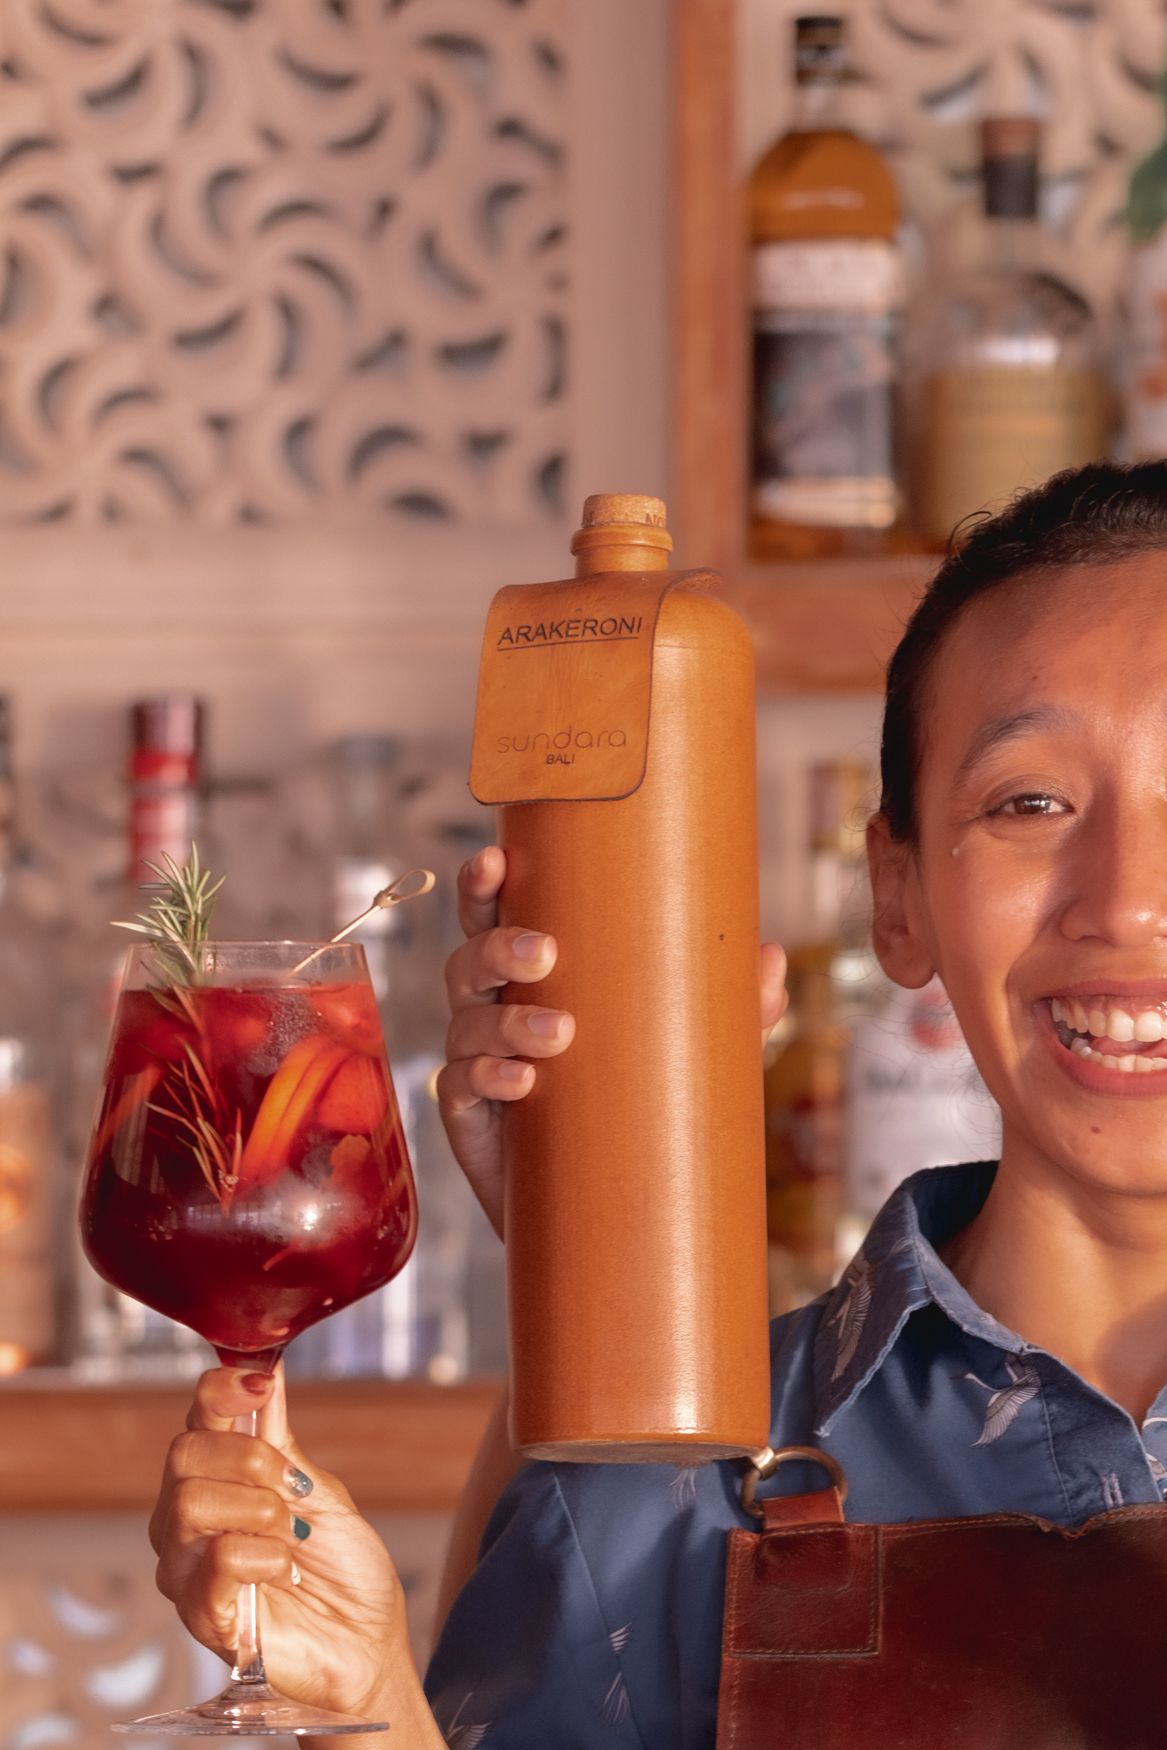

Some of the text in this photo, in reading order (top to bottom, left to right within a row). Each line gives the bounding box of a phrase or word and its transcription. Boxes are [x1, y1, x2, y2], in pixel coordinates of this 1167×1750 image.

[497, 617, 643, 646] ARAKERONI
[497, 726, 627, 753] sundara
[545, 753, 575, 765] BALI
